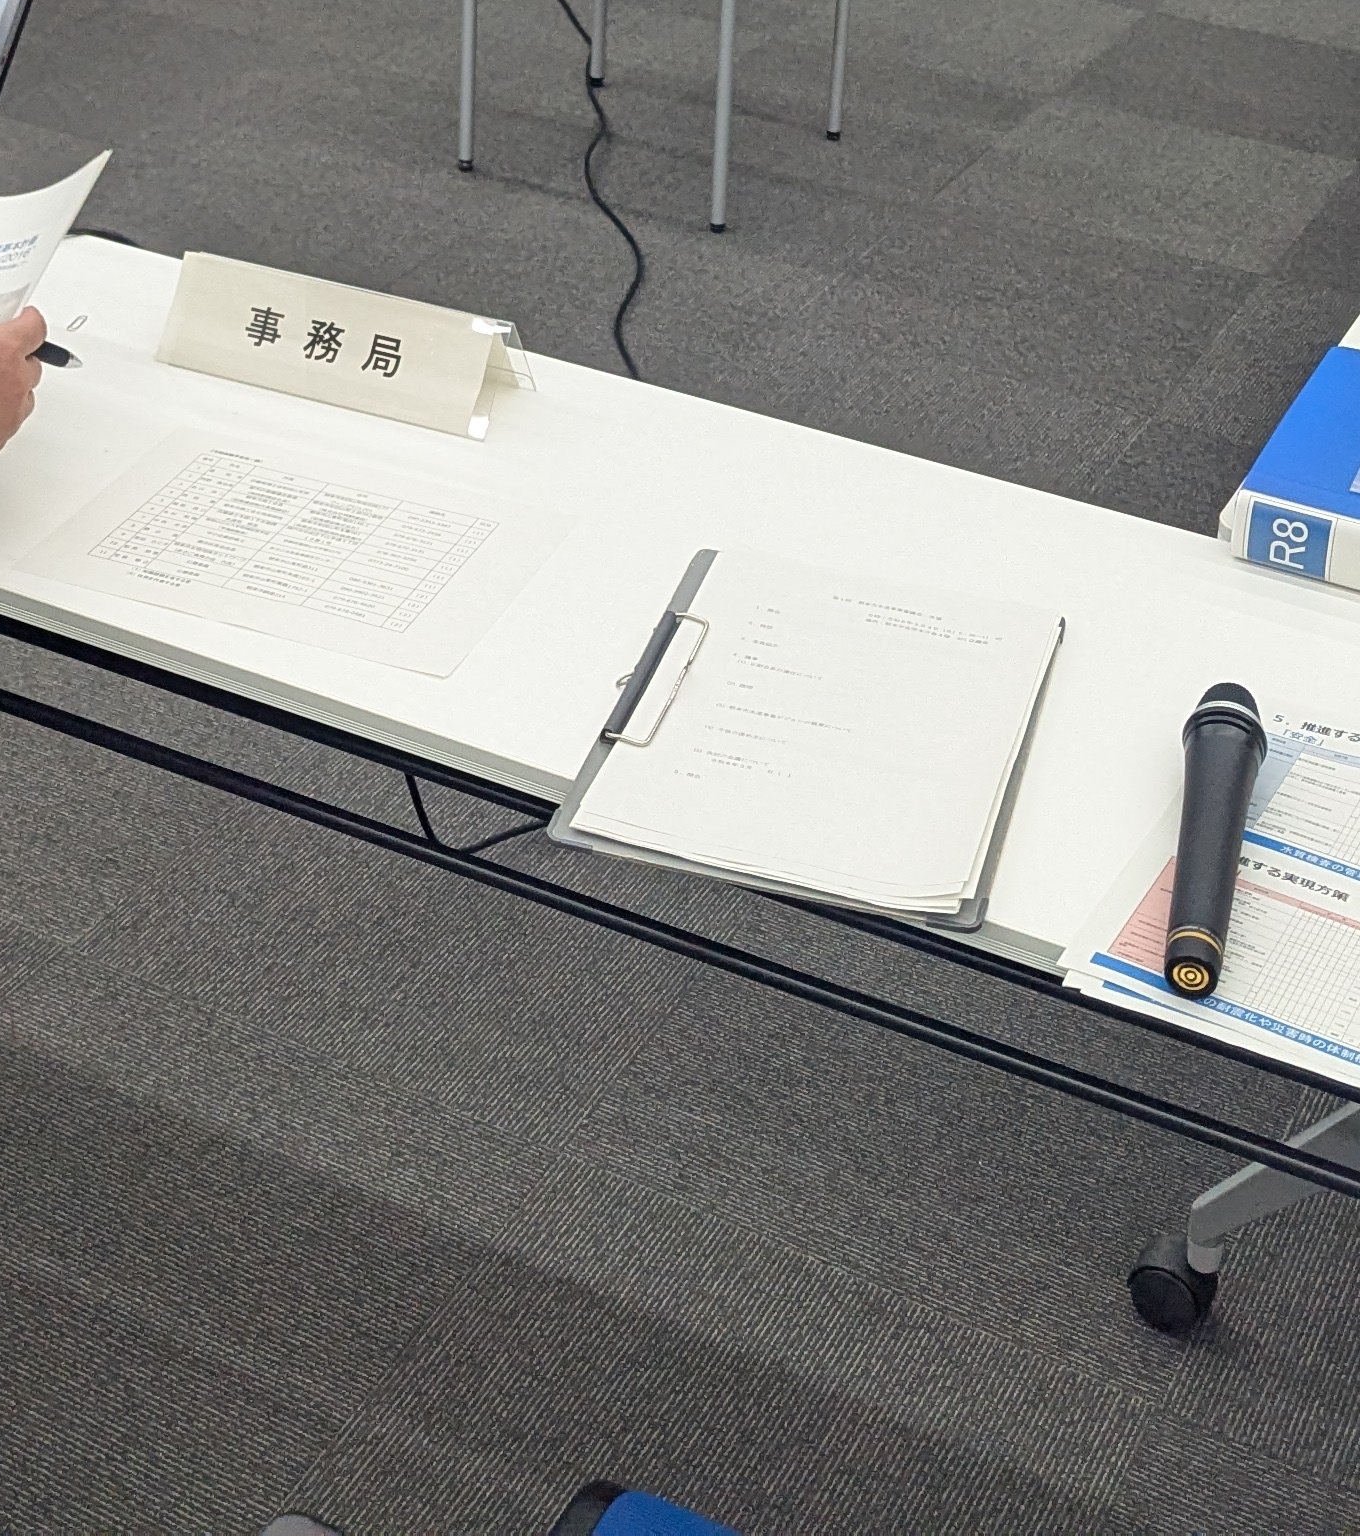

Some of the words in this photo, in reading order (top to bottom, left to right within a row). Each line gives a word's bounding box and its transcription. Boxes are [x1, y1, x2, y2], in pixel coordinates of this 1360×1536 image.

[244, 305, 403, 379] 事務局
[1268, 517, 1309, 571] R8
